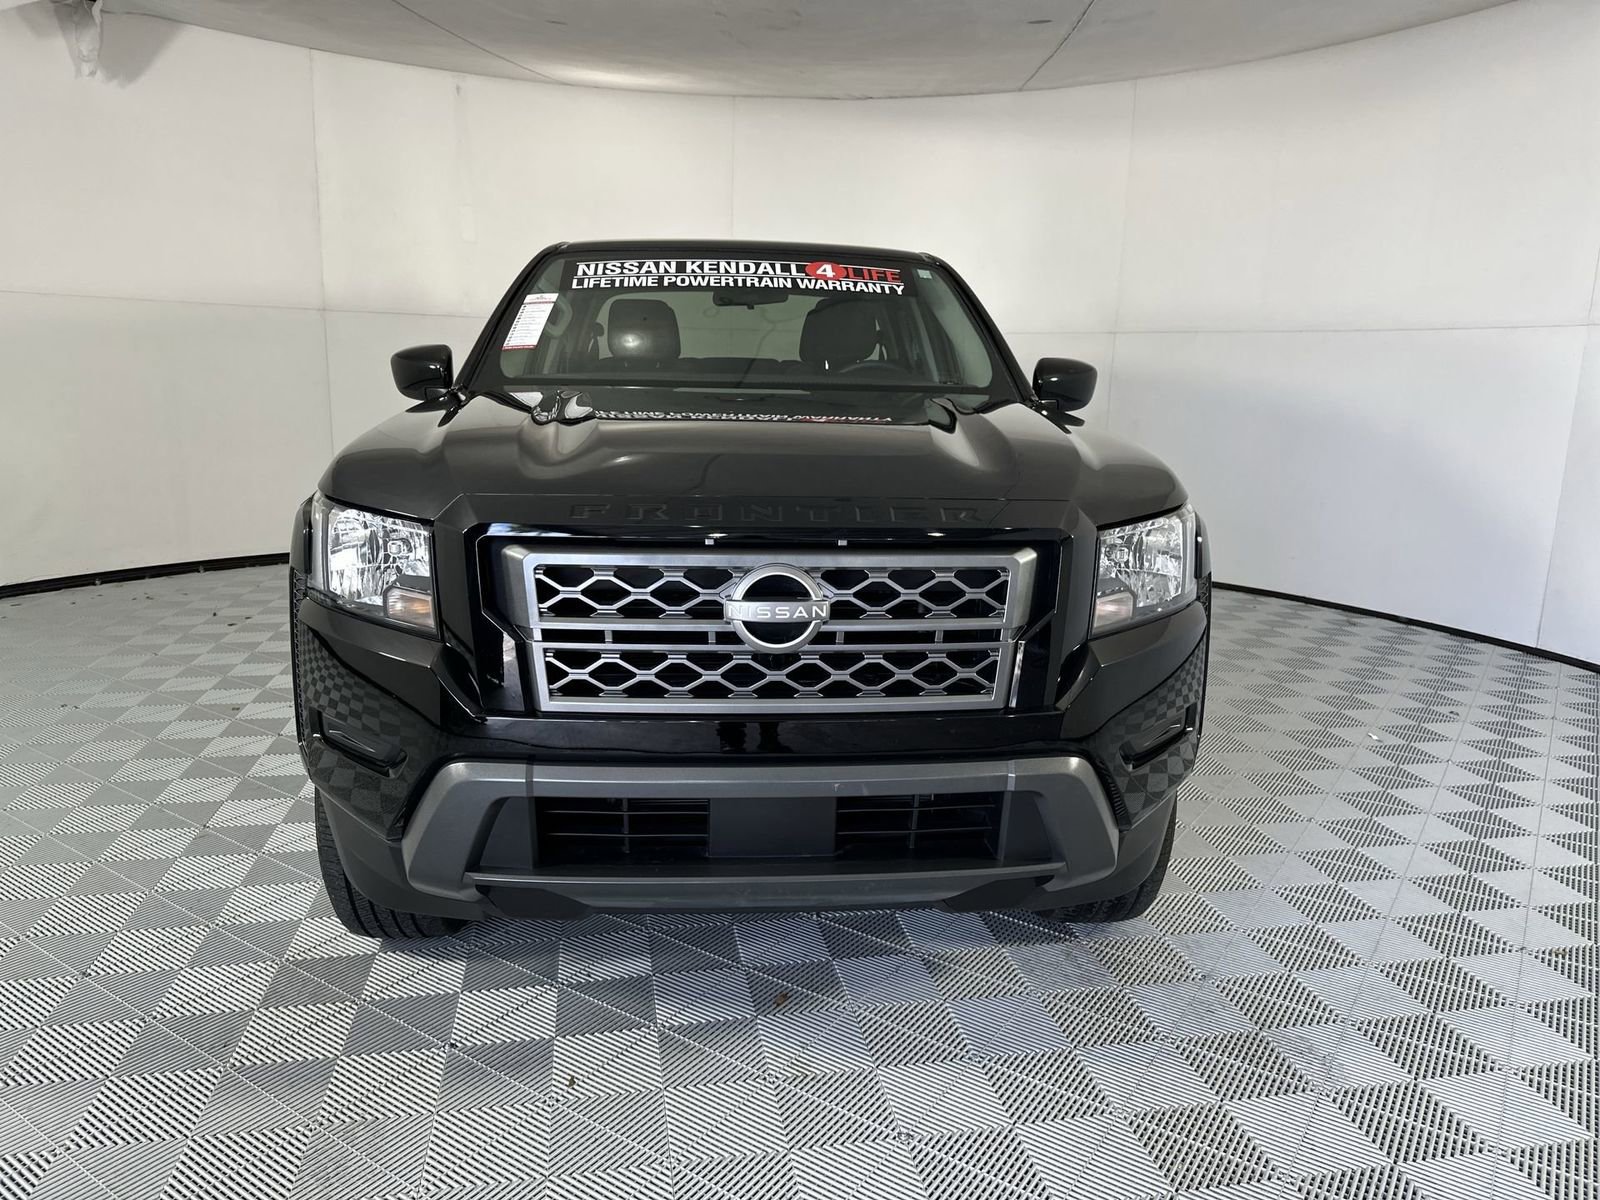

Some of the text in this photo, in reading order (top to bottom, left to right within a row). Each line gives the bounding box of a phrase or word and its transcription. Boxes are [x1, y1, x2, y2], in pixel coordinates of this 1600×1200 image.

[576, 261, 901, 282] NISSAN KENDALL 4 LIFE
[571, 275, 905, 295] LIFETIME POWERTRAIN WARRANTY
[569, 503, 984, 523] FRONTIER
[728, 605, 827, 619] NISSAN
